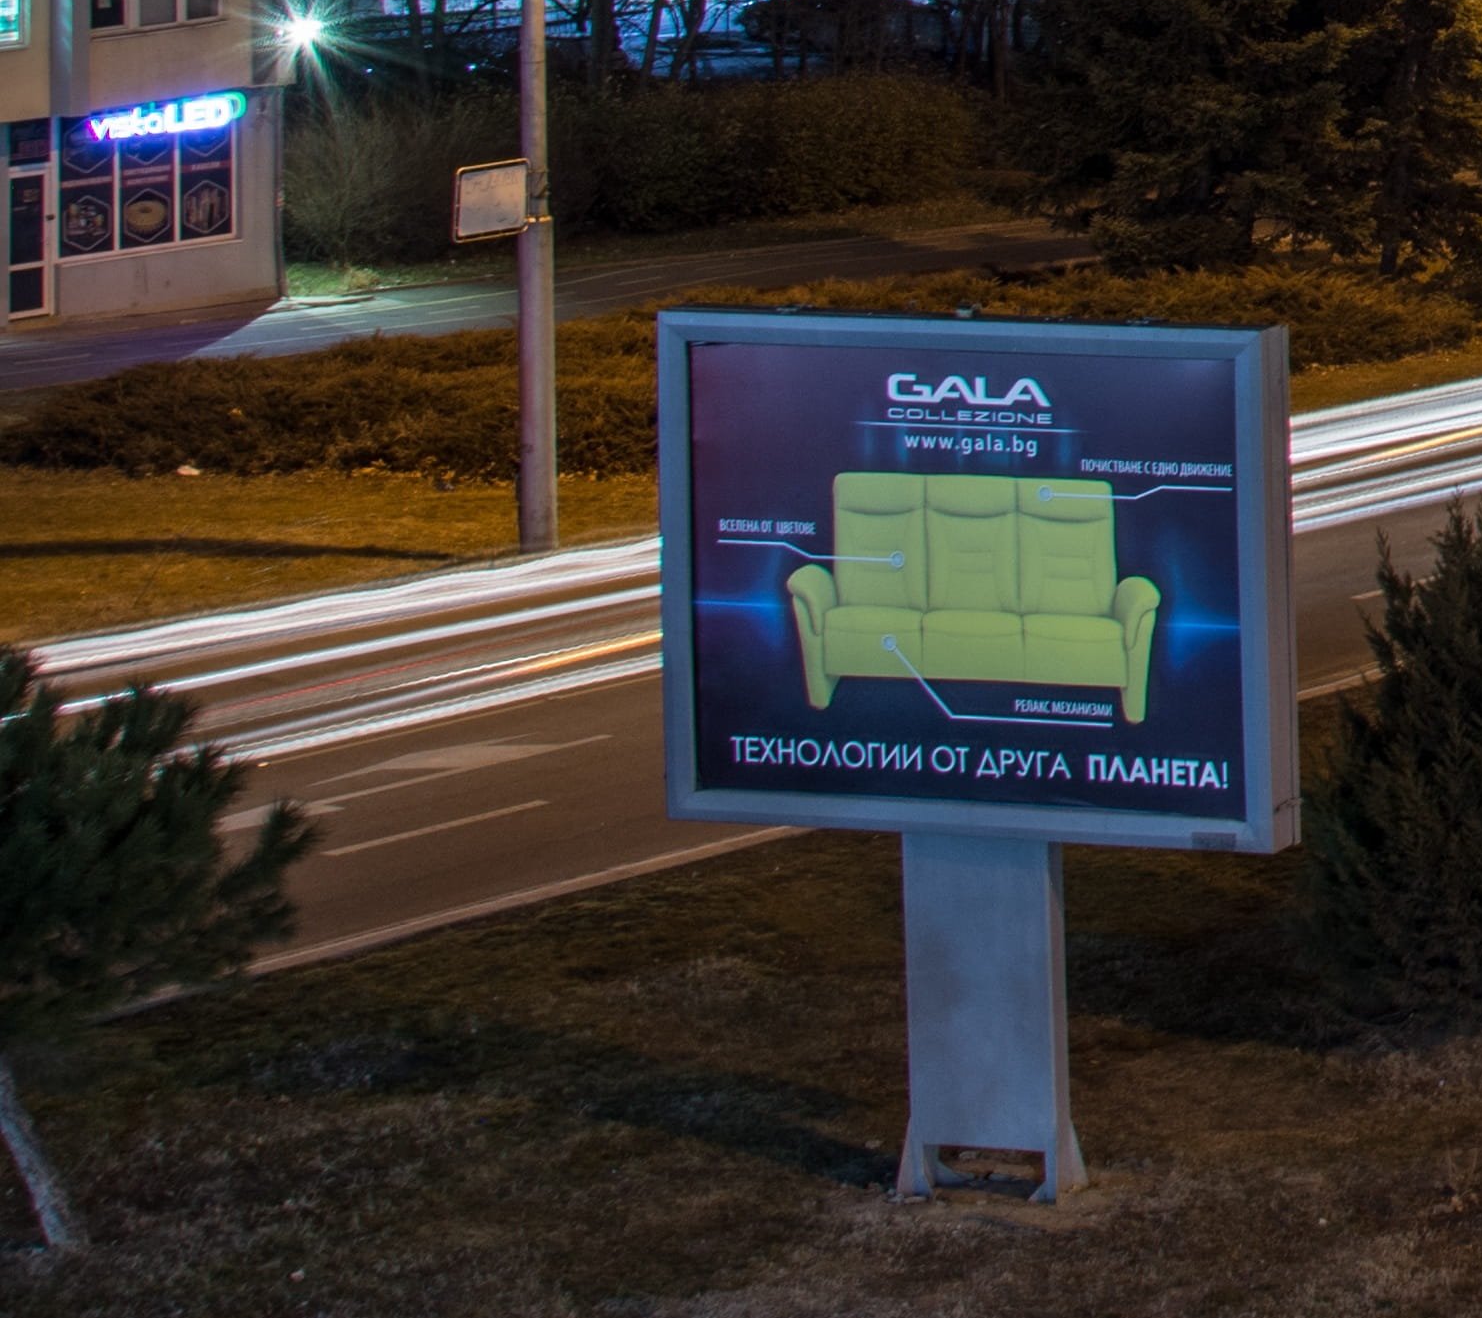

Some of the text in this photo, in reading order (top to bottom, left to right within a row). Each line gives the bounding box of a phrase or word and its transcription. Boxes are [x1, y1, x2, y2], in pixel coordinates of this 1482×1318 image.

[887, 372, 1051, 407] GALA
[887, 407, 1053, 425] COLLEZIONE
[904, 431, 1039, 457] www.gala.bg
[1080, 459, 1233, 478] ПОЧИСТВАНЕ С ЕДНО ДВИЖЕНИЕ
[719, 518, 817, 536] ВСЕЛЕНА ОТ ЦВЕТОВЕ
[1015, 699, 1113, 717] РЕЛАКС МЕХАНИЗМИ
[730, 735, 1229, 789] ТЕХНОЛОГИИ ОТ ДРУГА ПЛАНЕТА!
